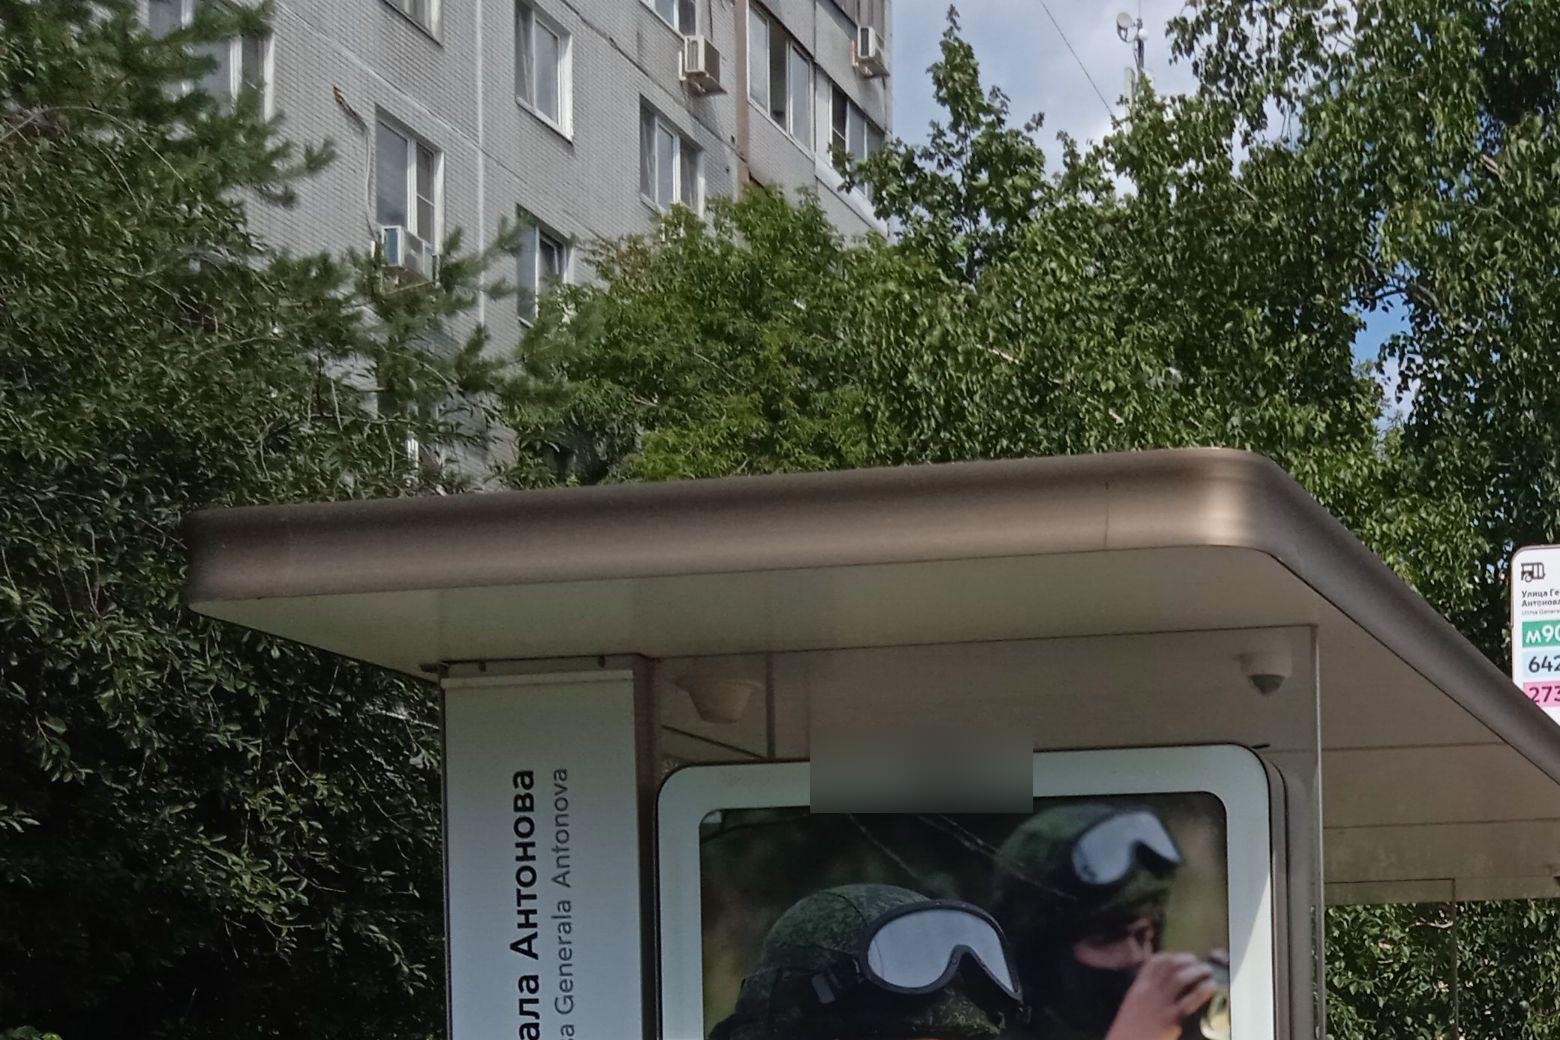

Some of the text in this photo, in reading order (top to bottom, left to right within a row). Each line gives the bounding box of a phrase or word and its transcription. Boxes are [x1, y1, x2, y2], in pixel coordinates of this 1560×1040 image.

[1521, 590, 1548, 598] Улица
[509, 769, 539, 961] Антонова
[551, 768, 571, 888] Antonova
[551, 899, 575, 1015] Generala
